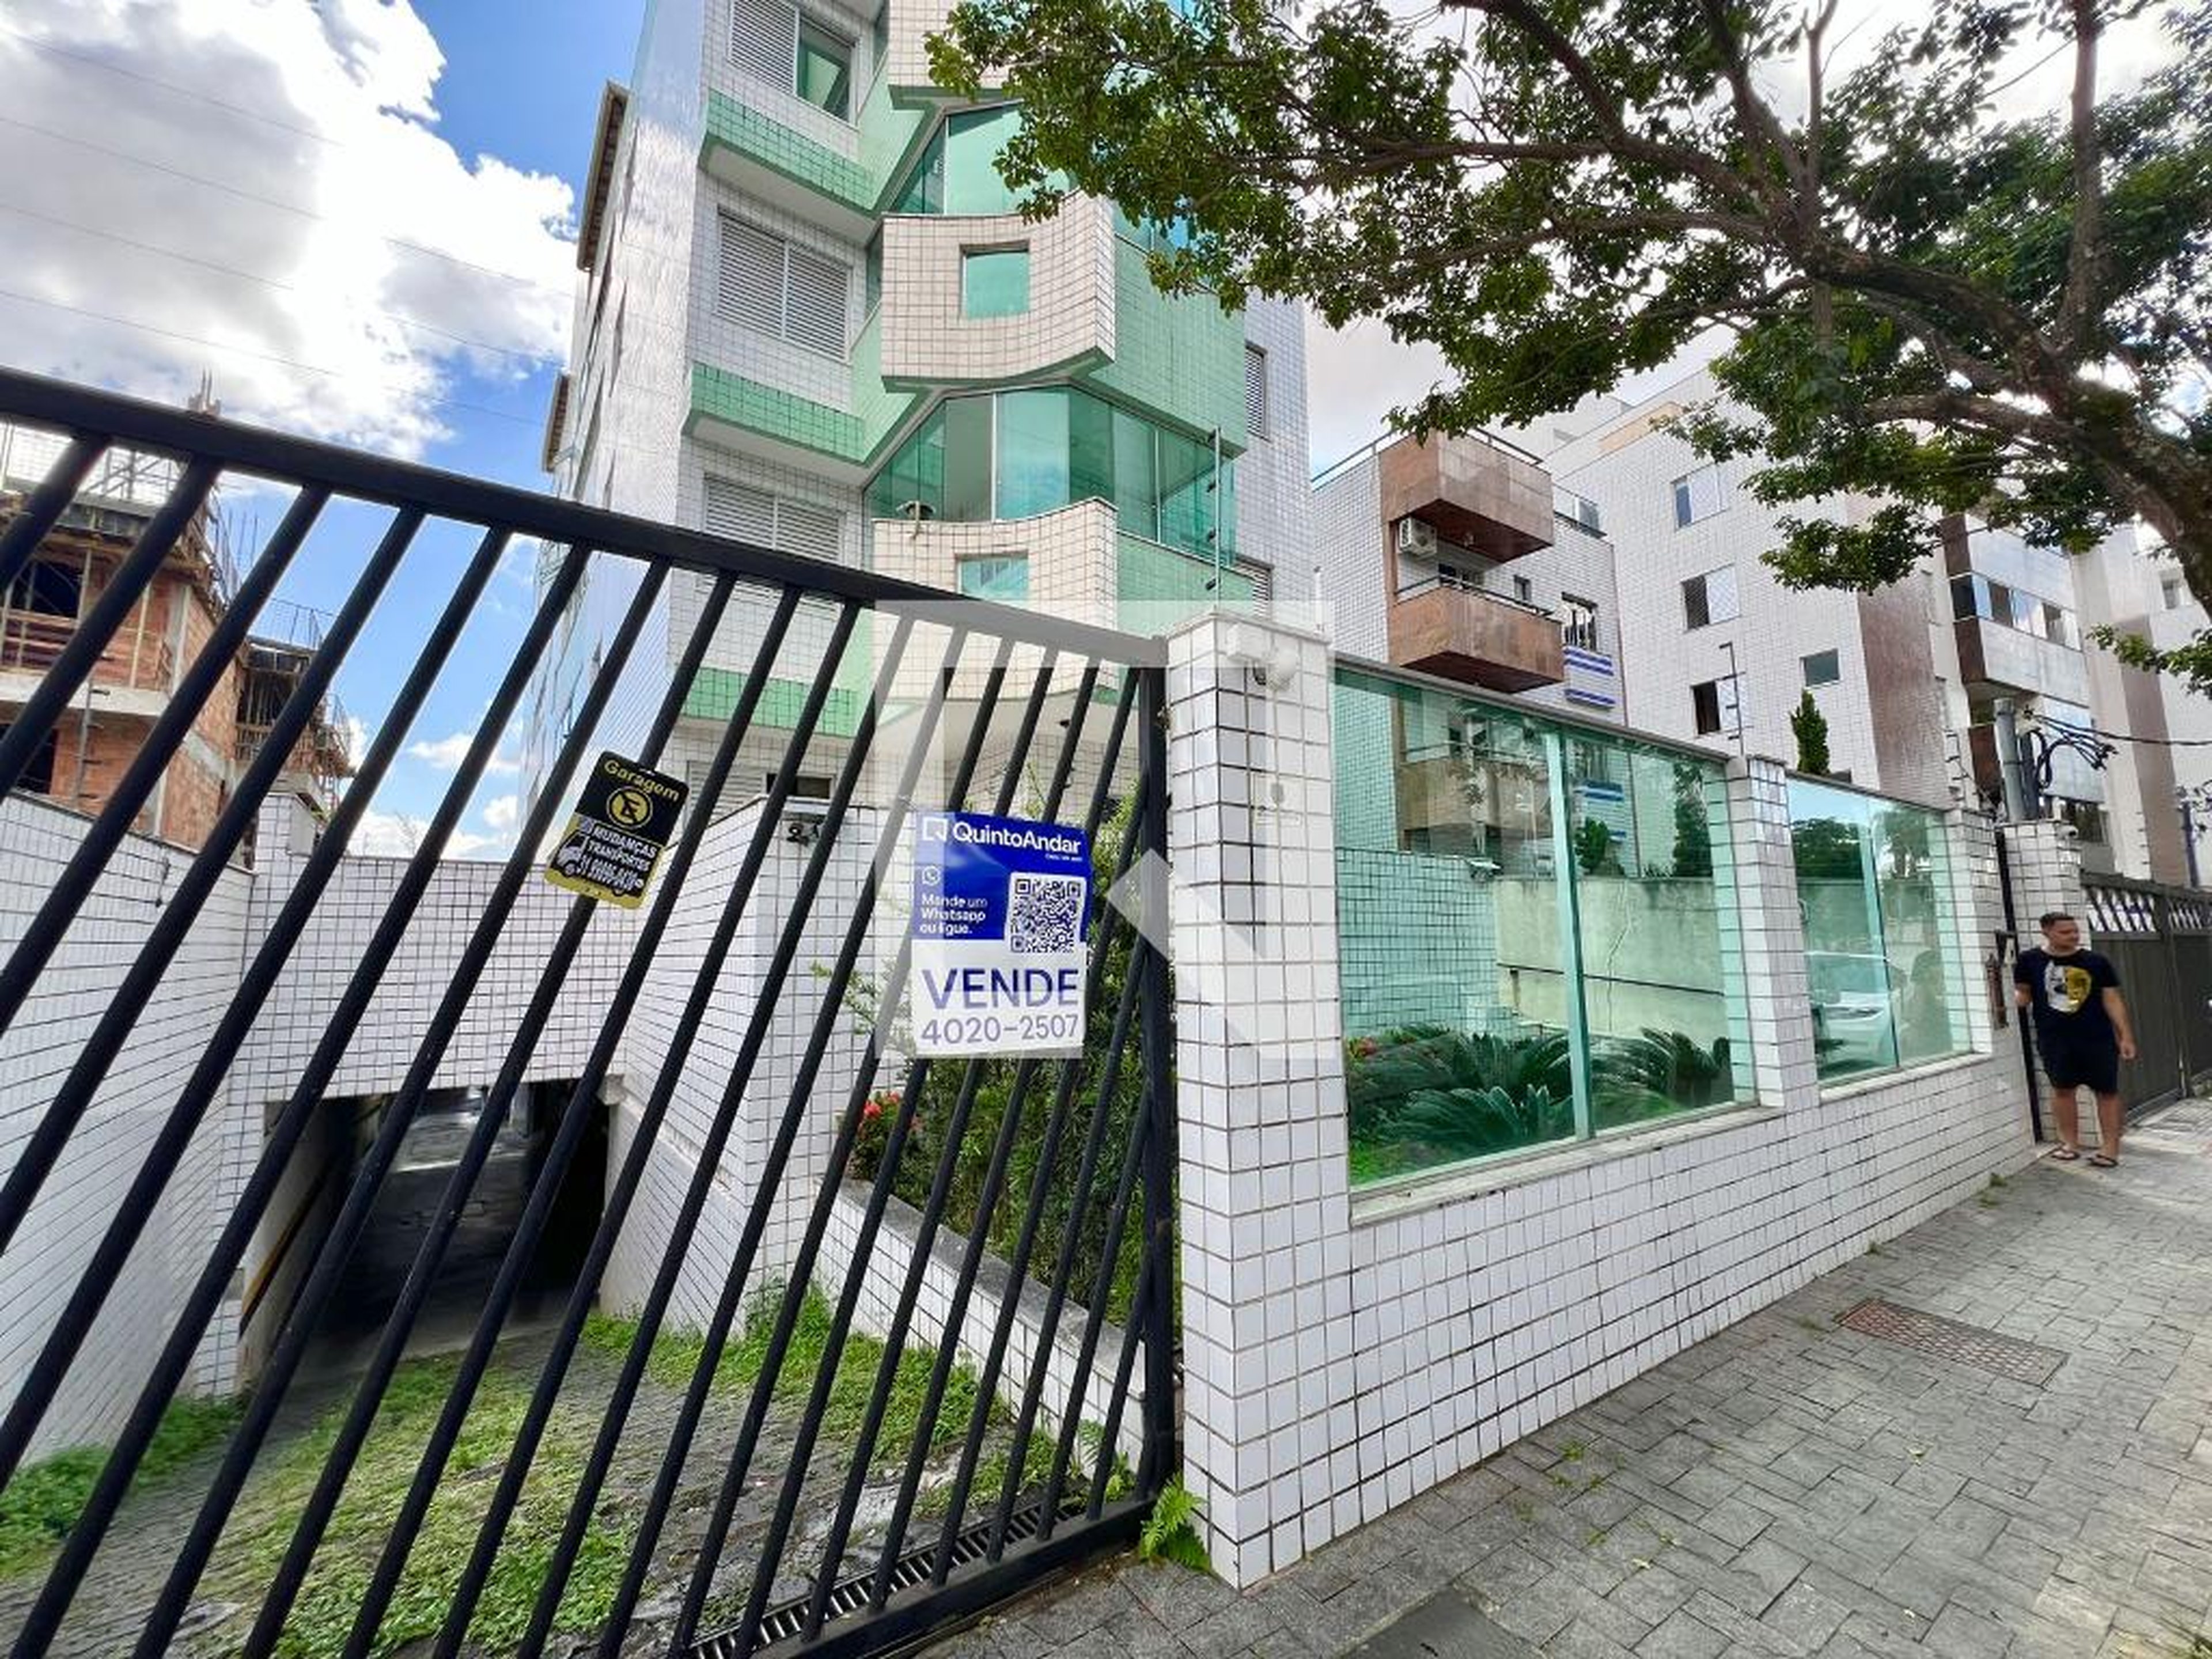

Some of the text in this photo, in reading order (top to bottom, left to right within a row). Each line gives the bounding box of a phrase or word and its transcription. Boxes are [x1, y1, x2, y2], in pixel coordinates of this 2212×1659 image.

[952, 821, 1081, 854] QuintoAndar
[921, 893, 988, 908] Mande um
[921, 907, 986, 923] Whatsapp
[919, 923, 936, 934] ou
[922, 968, 1079, 1009] VENDE
[922, 1014, 1079, 1045] 4020-2507
